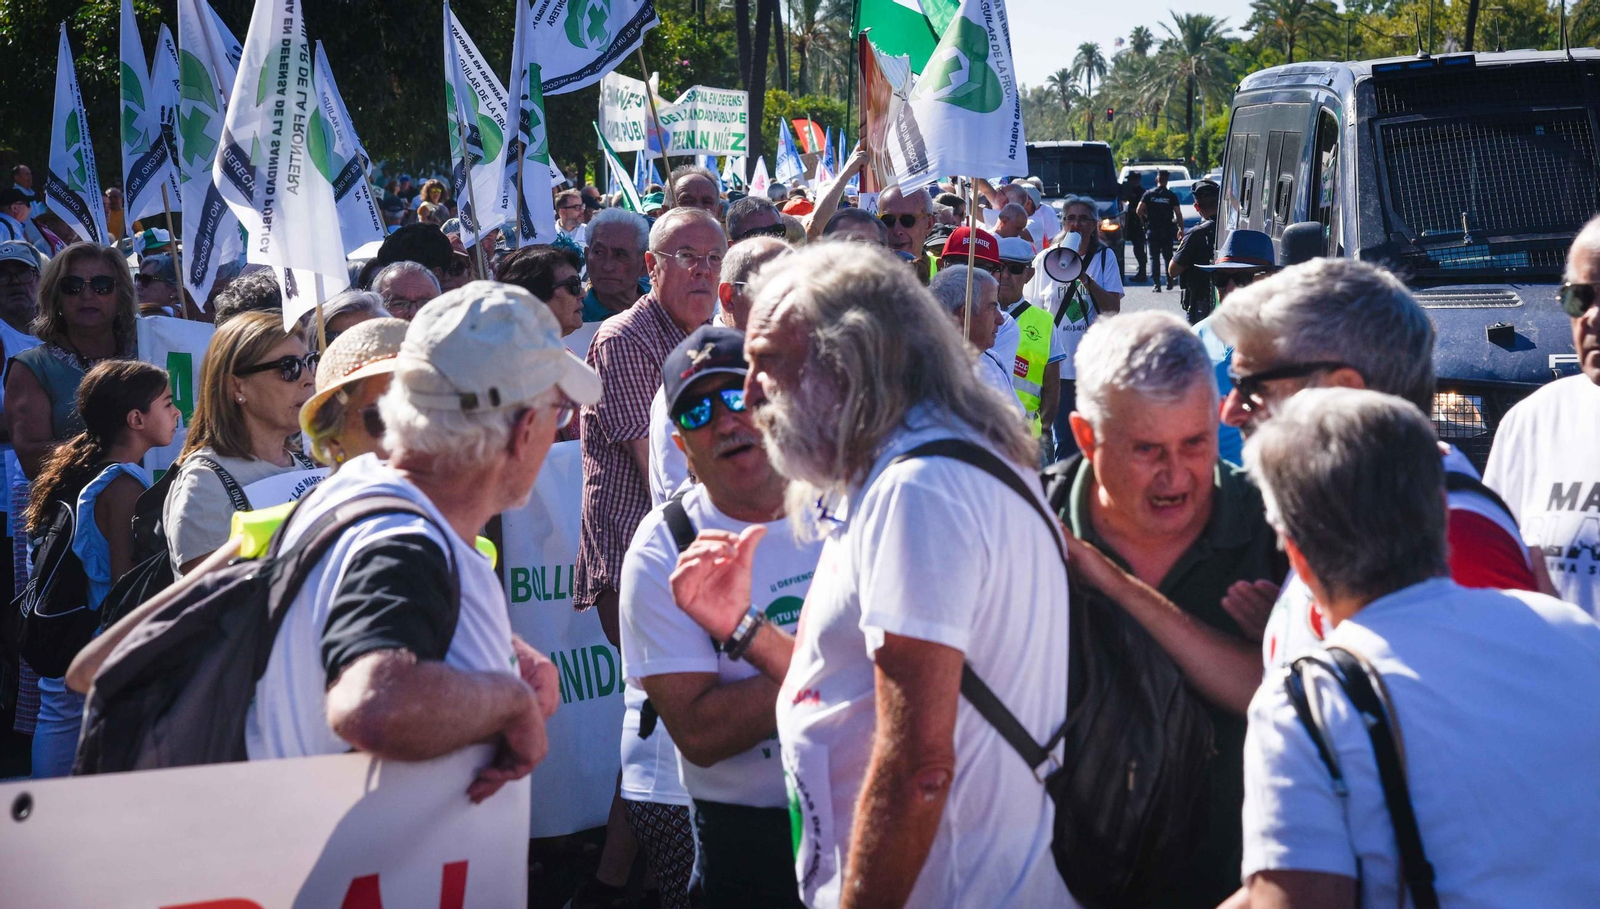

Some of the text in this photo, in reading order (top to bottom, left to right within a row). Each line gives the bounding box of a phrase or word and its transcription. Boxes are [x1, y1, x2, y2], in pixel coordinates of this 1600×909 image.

[997, 10, 1005, 22] EN
[991, 43, 1004, 59] DE
[996, 60, 1008, 74] LA
[473, 60, 483, 71] EN
[480, 70, 504, 102] DEFENSA
[477, 89, 490, 102] DE
[486, 102, 498, 115] LA
[660, 114, 678, 126] DE
[902, 130, 910, 142] UN
[367, 199, 381, 233] PÚBLICA
